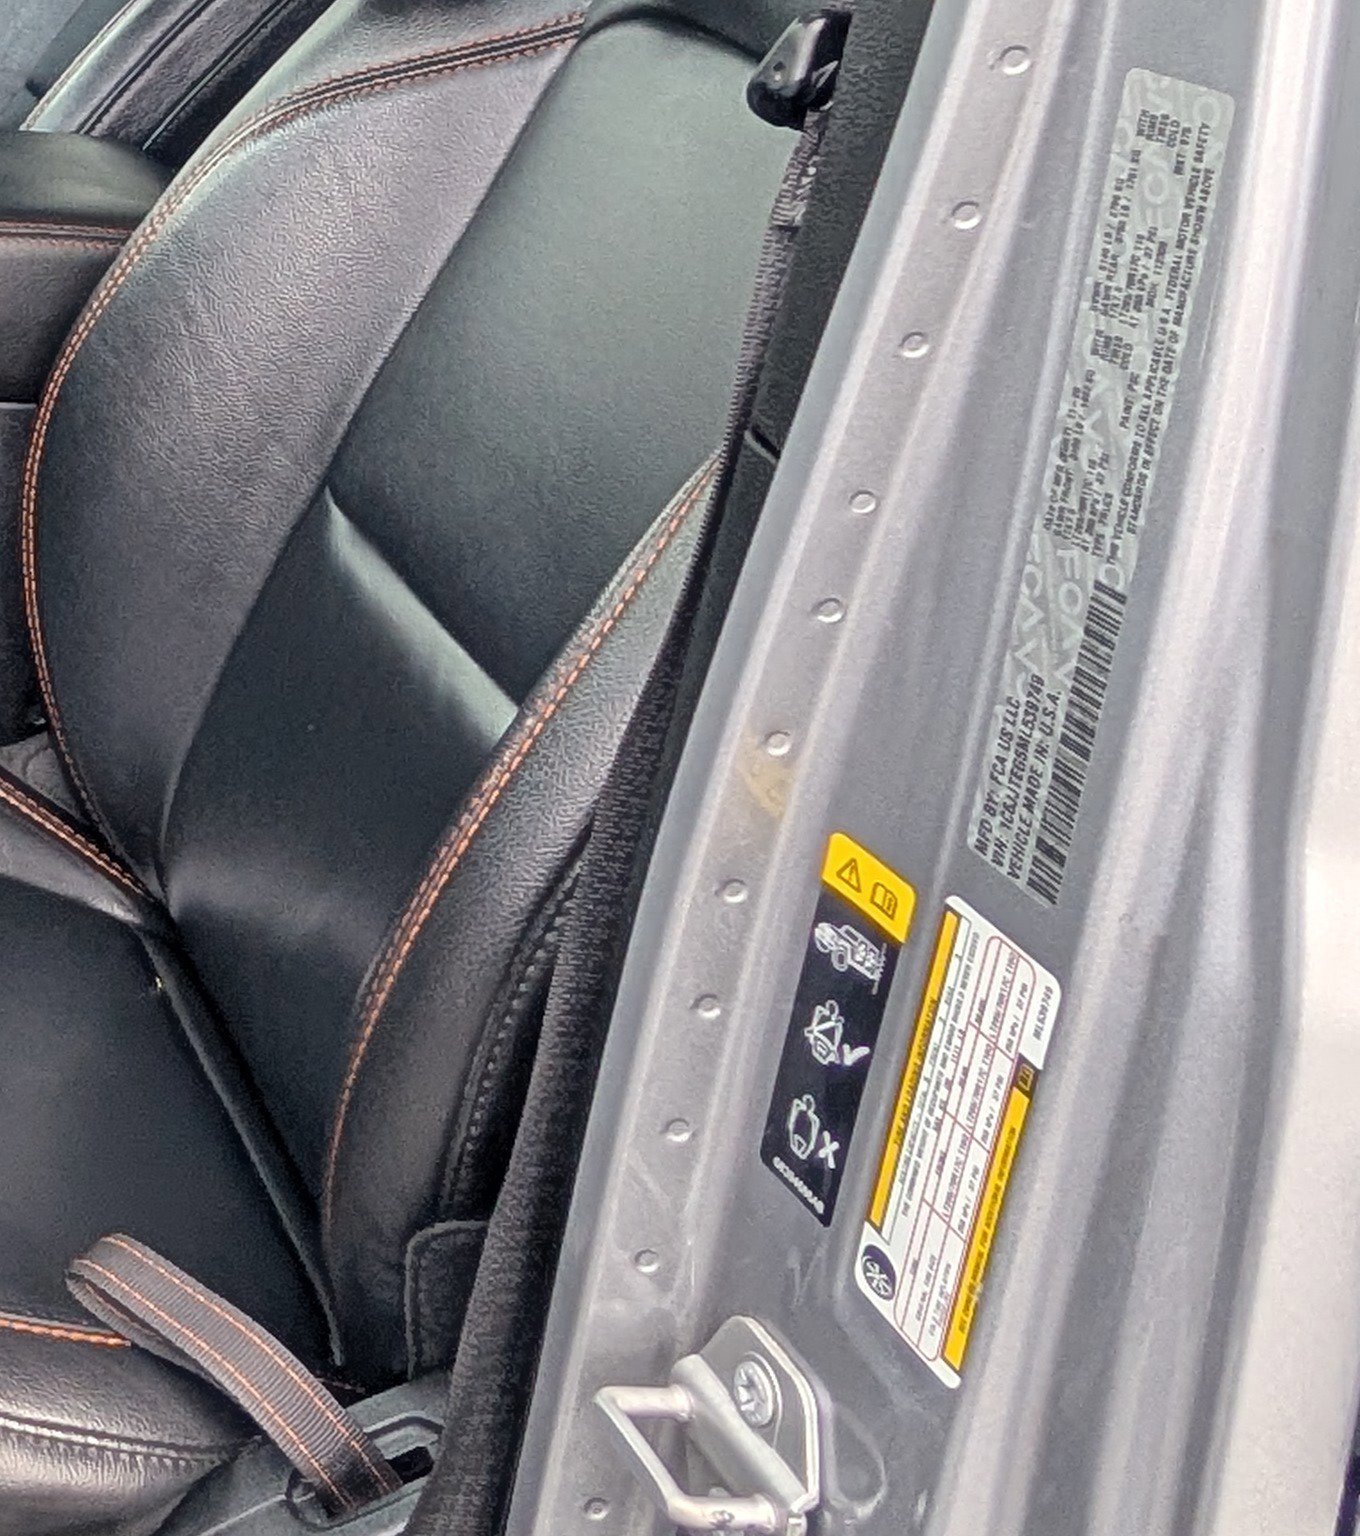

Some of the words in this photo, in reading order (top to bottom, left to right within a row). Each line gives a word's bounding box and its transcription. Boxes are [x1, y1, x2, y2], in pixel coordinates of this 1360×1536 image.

[1002, 694, 1019, 726] LLC
[997, 725, 1012, 752] US
[990, 752, 1007, 785] FCA
[983, 787, 999, 817] BY:
[975, 816, 993, 856] MFD
[1007, 813, 1031, 882] VEHICLE
[1021, 765, 1042, 814] MADE
[991, 833, 1008, 869] VIN:
